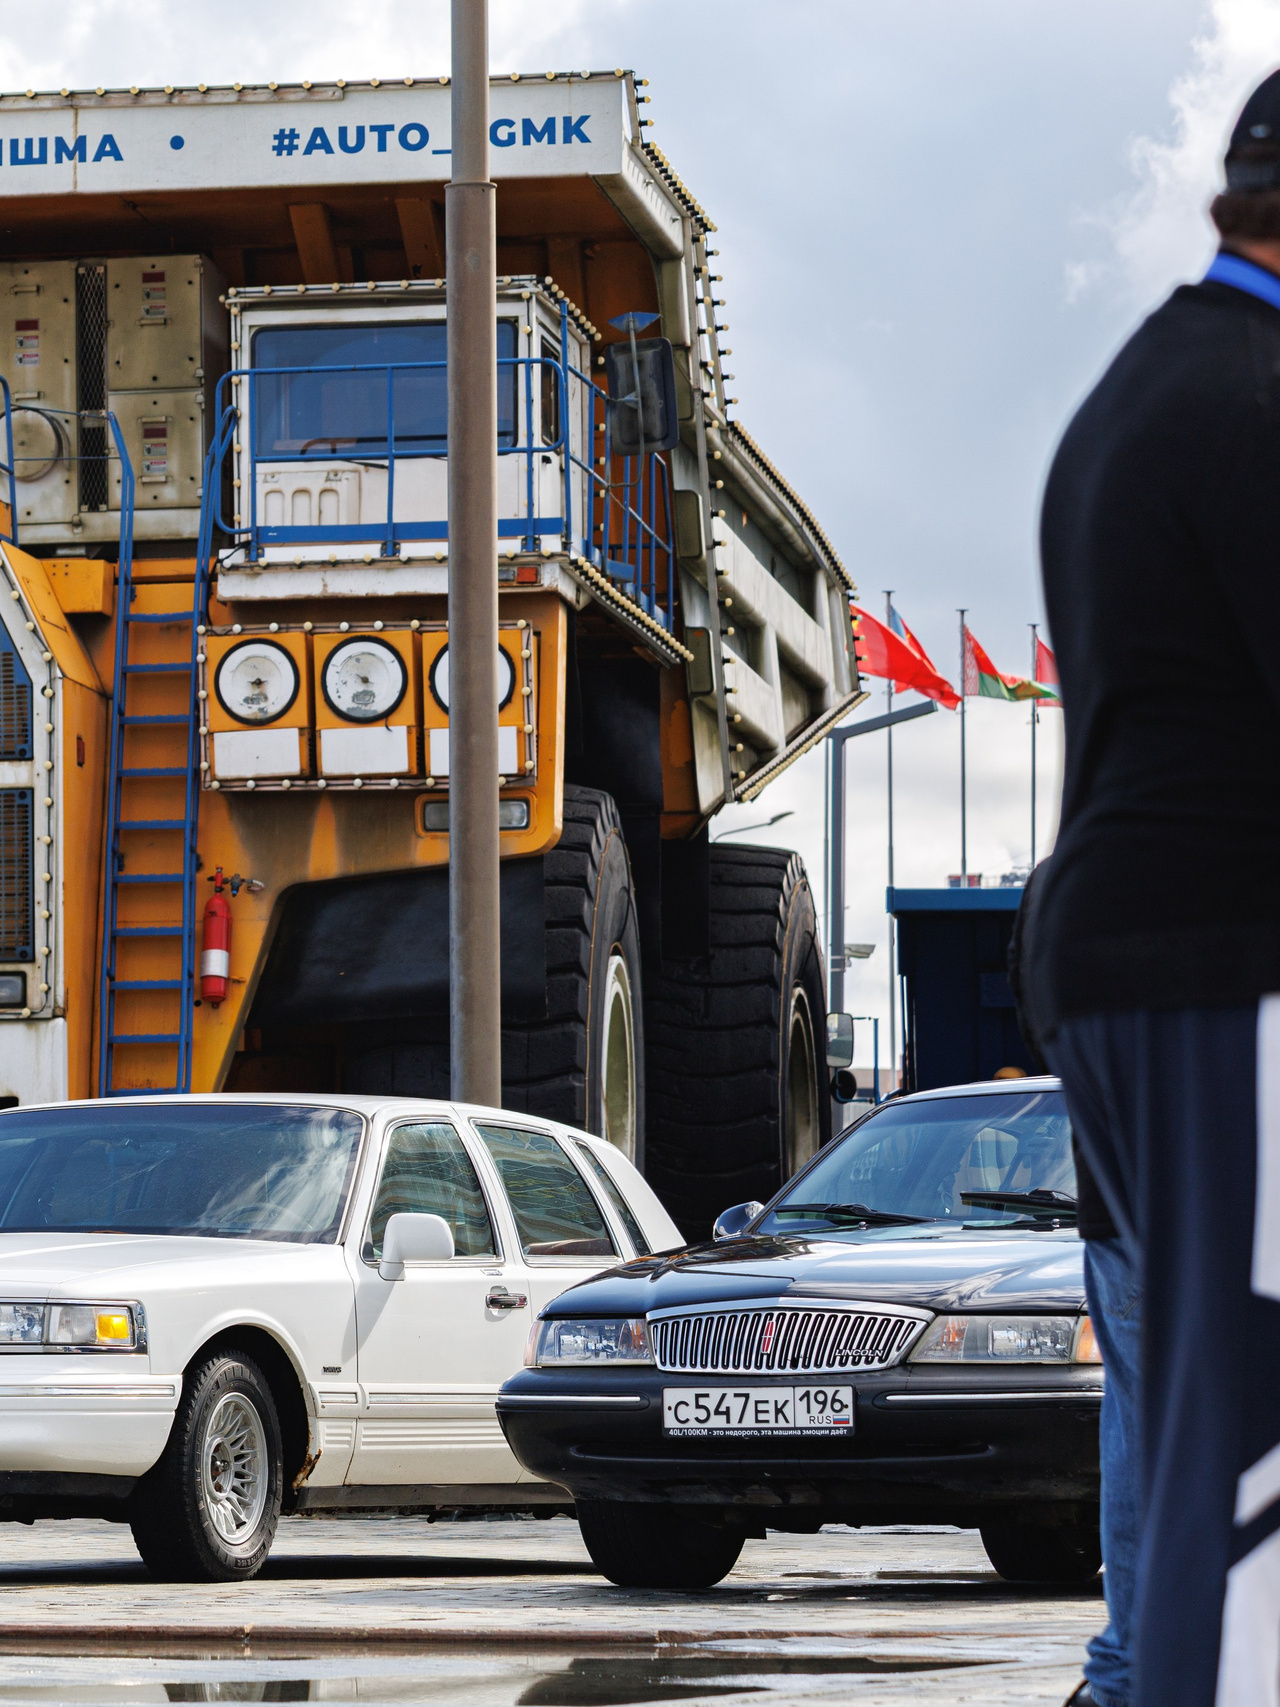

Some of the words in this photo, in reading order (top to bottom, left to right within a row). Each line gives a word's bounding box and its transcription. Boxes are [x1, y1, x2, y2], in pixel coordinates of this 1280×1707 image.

[271, 114, 592, 157] #AUTO_GMK
[835, 1349, 883, 1357] LINCOLN
[798, 1389, 843, 1414] 196
[809, 1416, 831, 1424] RUS
